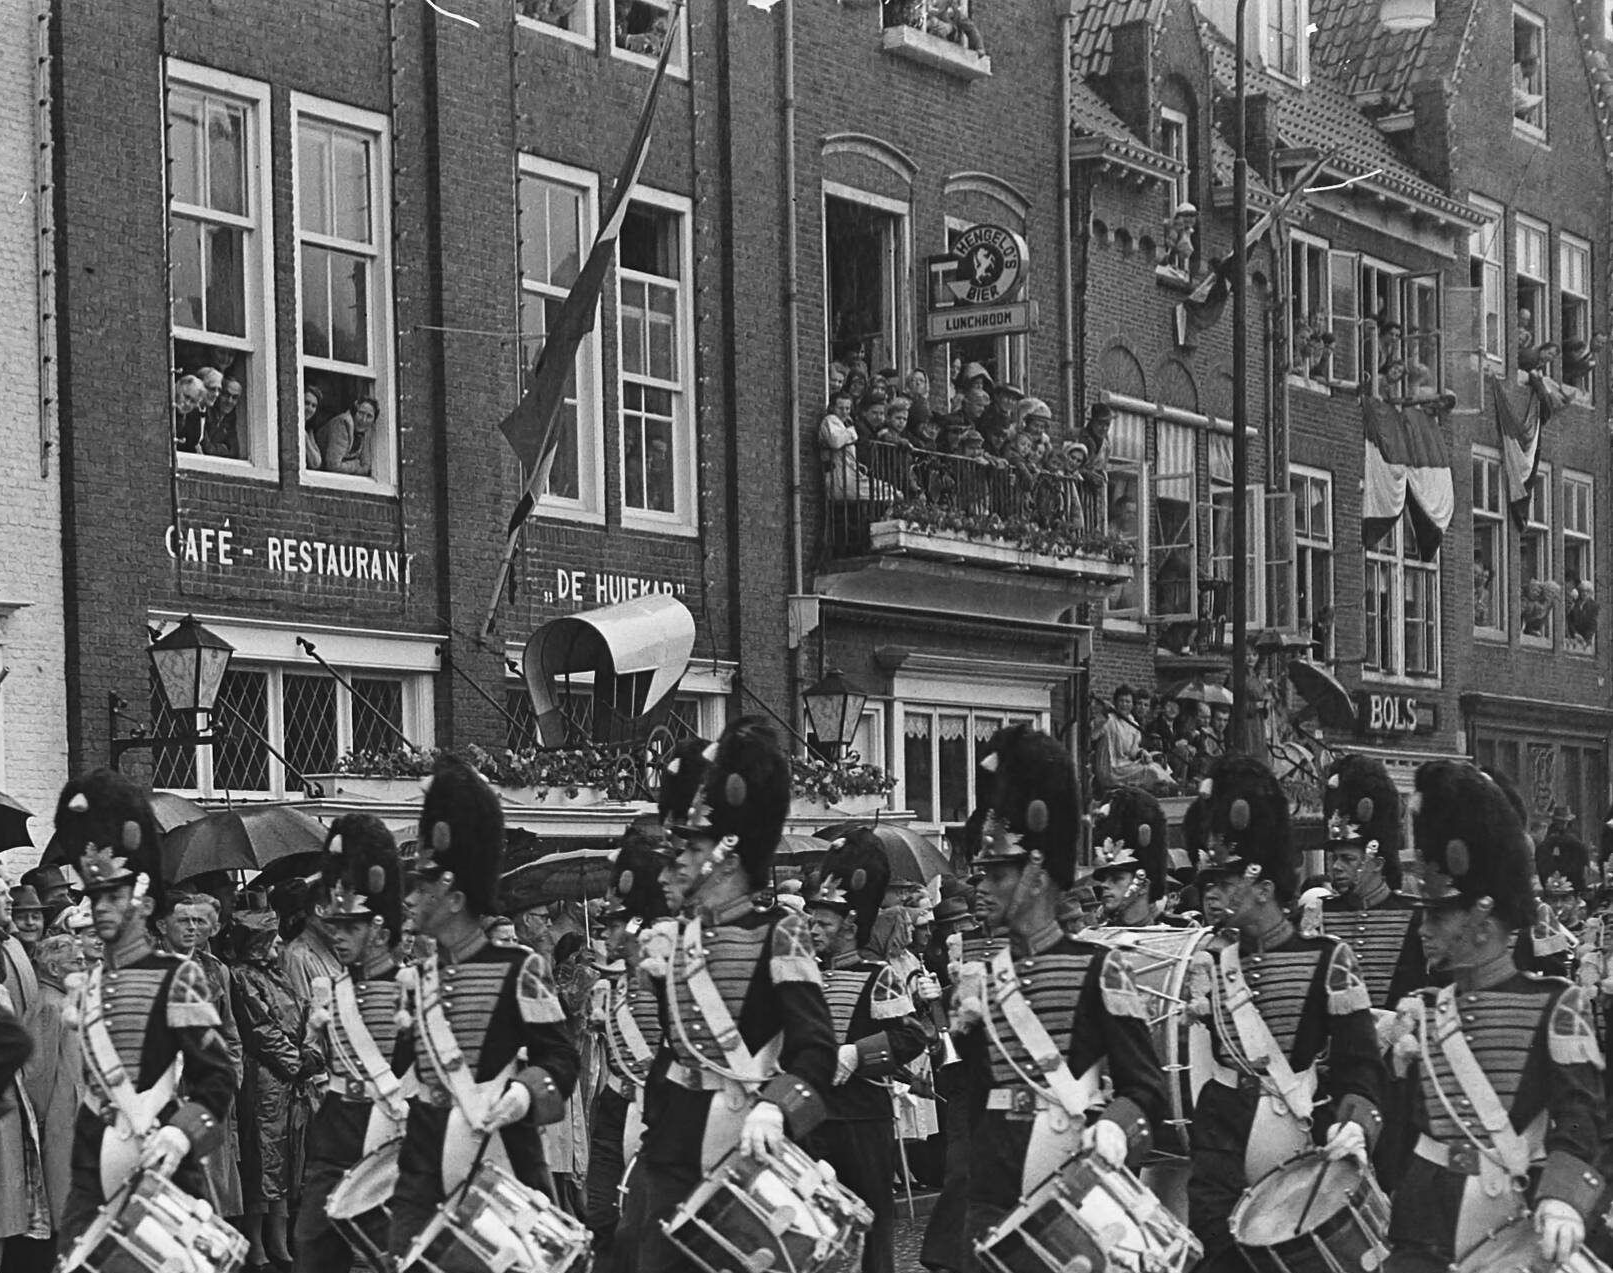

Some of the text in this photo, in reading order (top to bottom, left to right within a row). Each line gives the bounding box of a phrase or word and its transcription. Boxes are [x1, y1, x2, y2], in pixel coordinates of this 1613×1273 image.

[966, 285, 1000, 301] BIER
[945, 311, 1013, 332] LUNCHROOM
[165, 518, 233, 565] CAFÉ
[268, 537, 416, 584] RESTAURANT
[1370, 694, 1418, 731] BOLS
